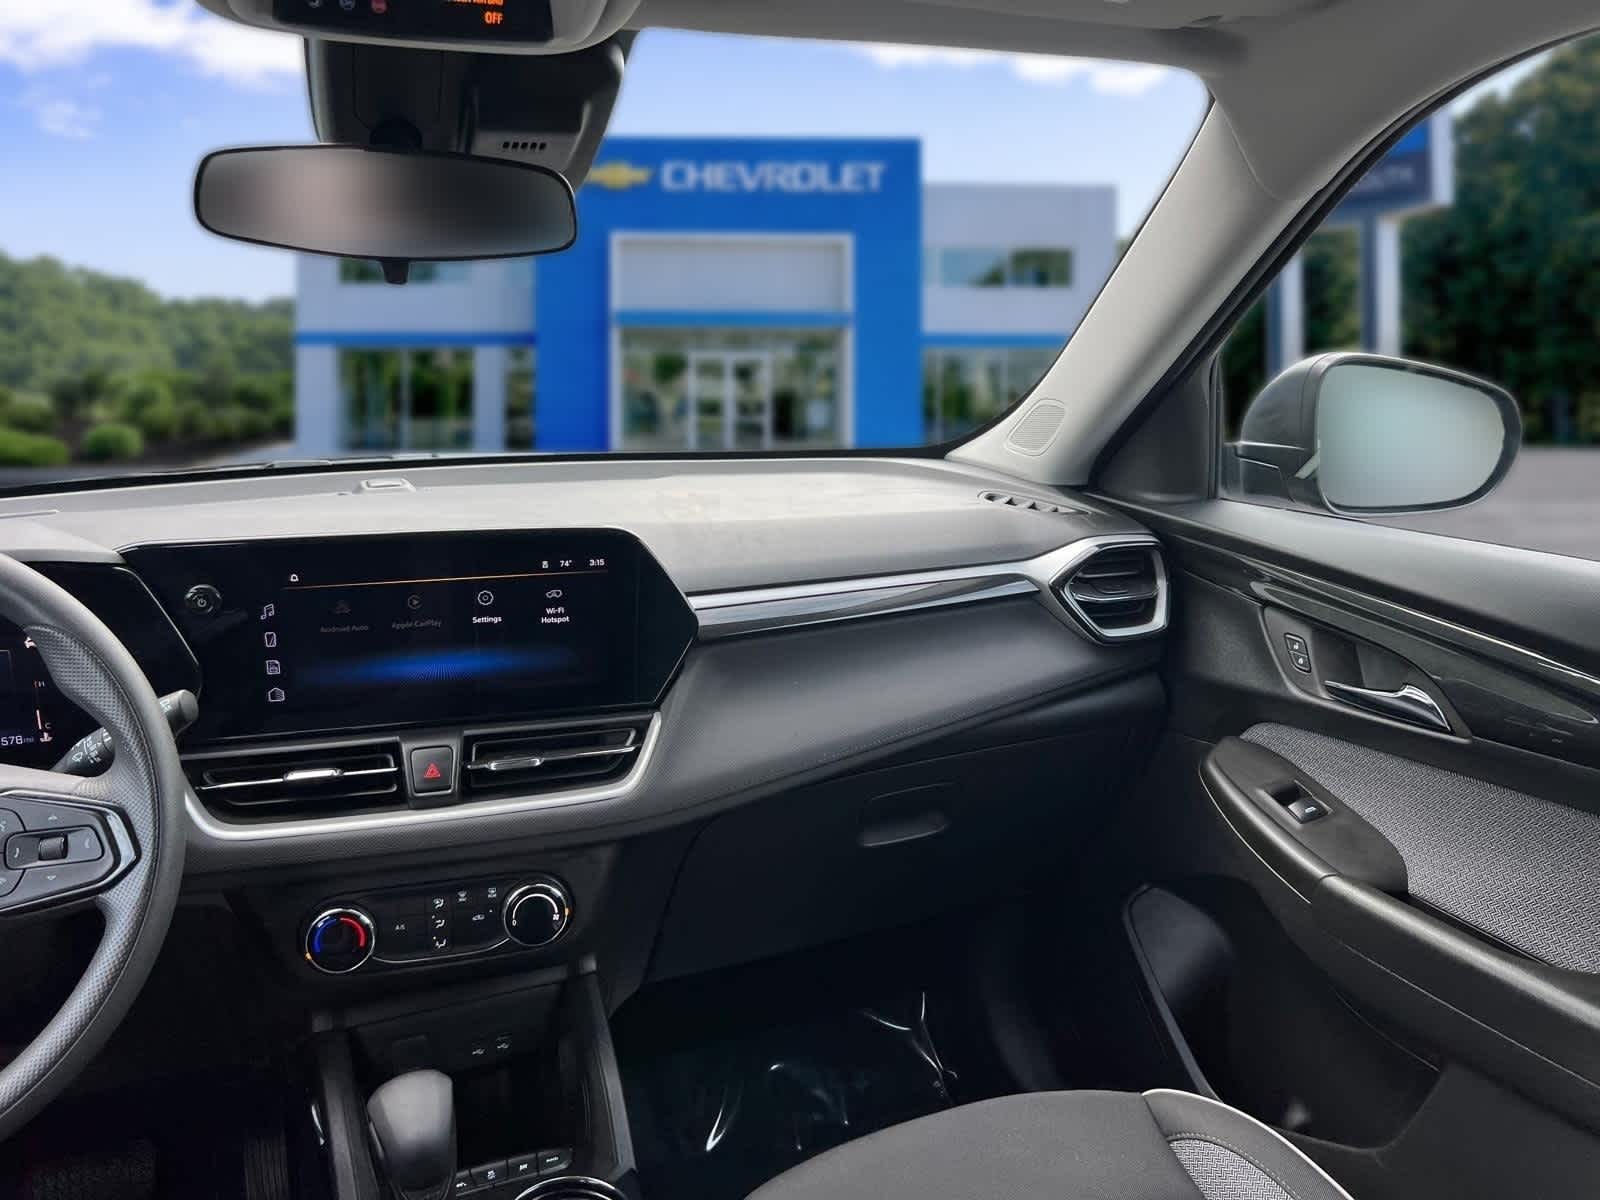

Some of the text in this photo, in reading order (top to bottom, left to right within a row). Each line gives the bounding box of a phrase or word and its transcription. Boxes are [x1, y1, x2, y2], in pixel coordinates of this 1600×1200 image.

[484, 11, 503, 24] OFF
[660, 160, 885, 192] CHEVROLET
[589, 559, 605, 567] 3:15
[472, 616, 502, 624] Settings
[541, 616, 570, 624] Hotspot
